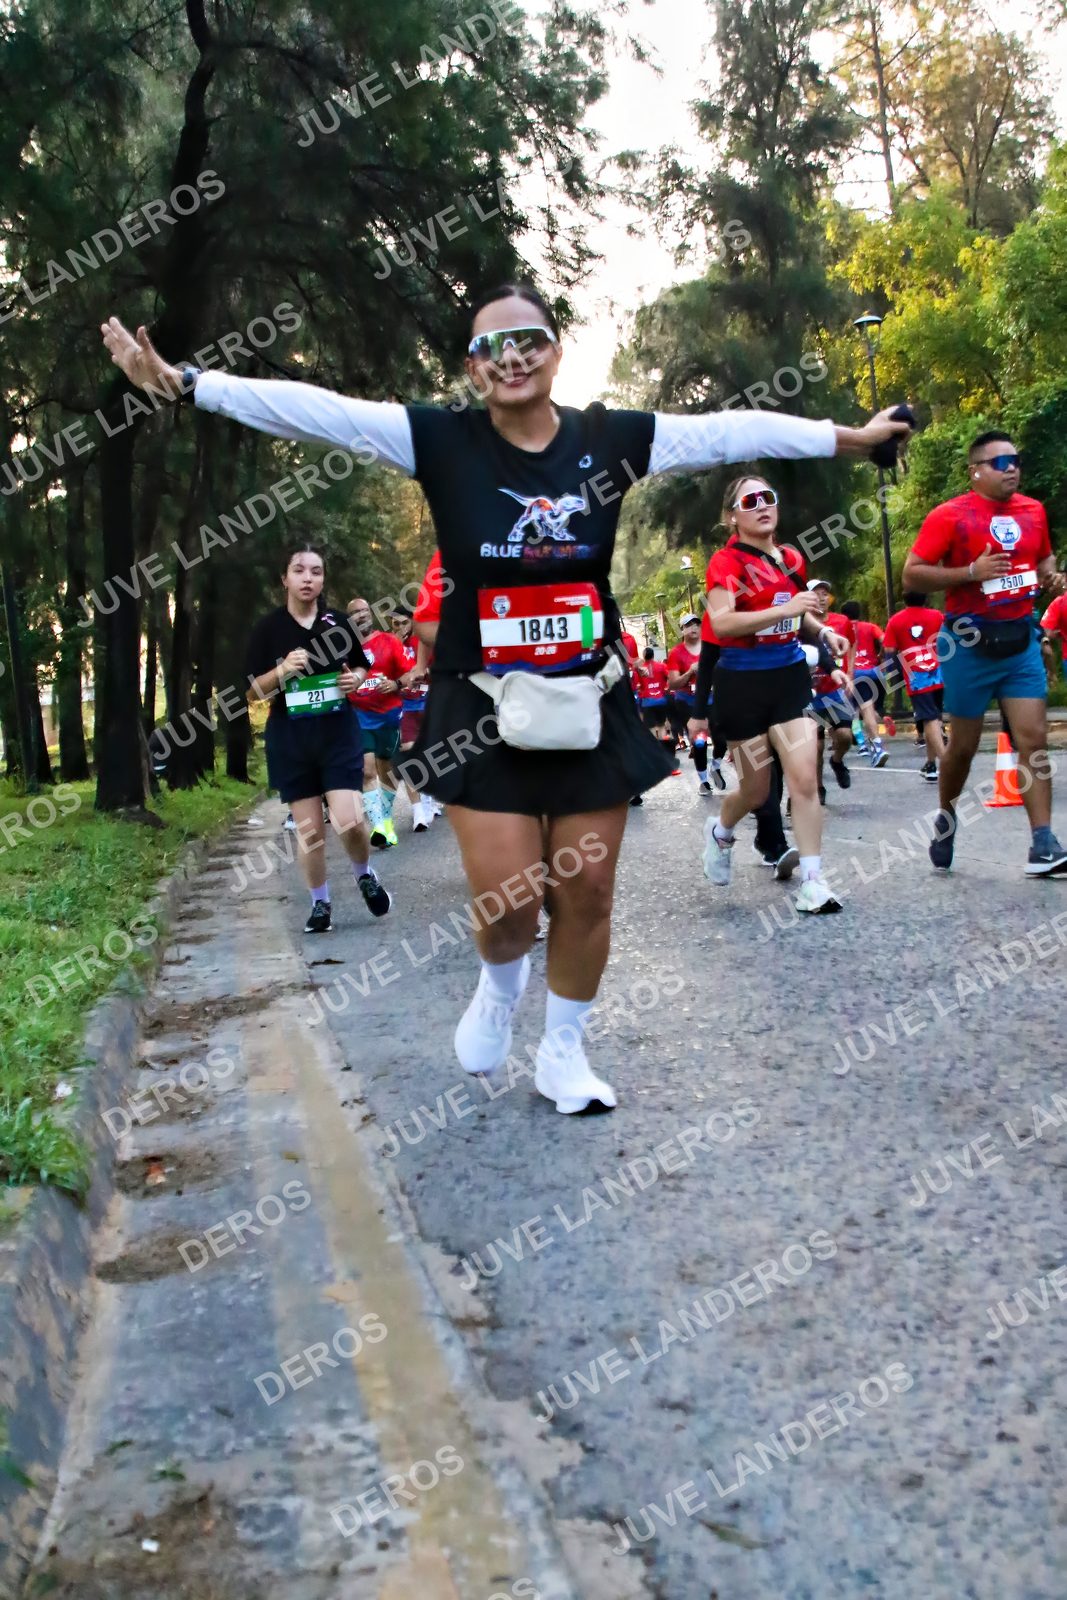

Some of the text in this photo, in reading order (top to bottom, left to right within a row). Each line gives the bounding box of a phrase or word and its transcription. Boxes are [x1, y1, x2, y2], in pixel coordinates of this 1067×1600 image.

[480, 544, 522, 558] BLUE
[1000, 575, 1024, 590] 2500
[518, 617, 568, 643] 1843
[308, 690, 325, 703] 221
